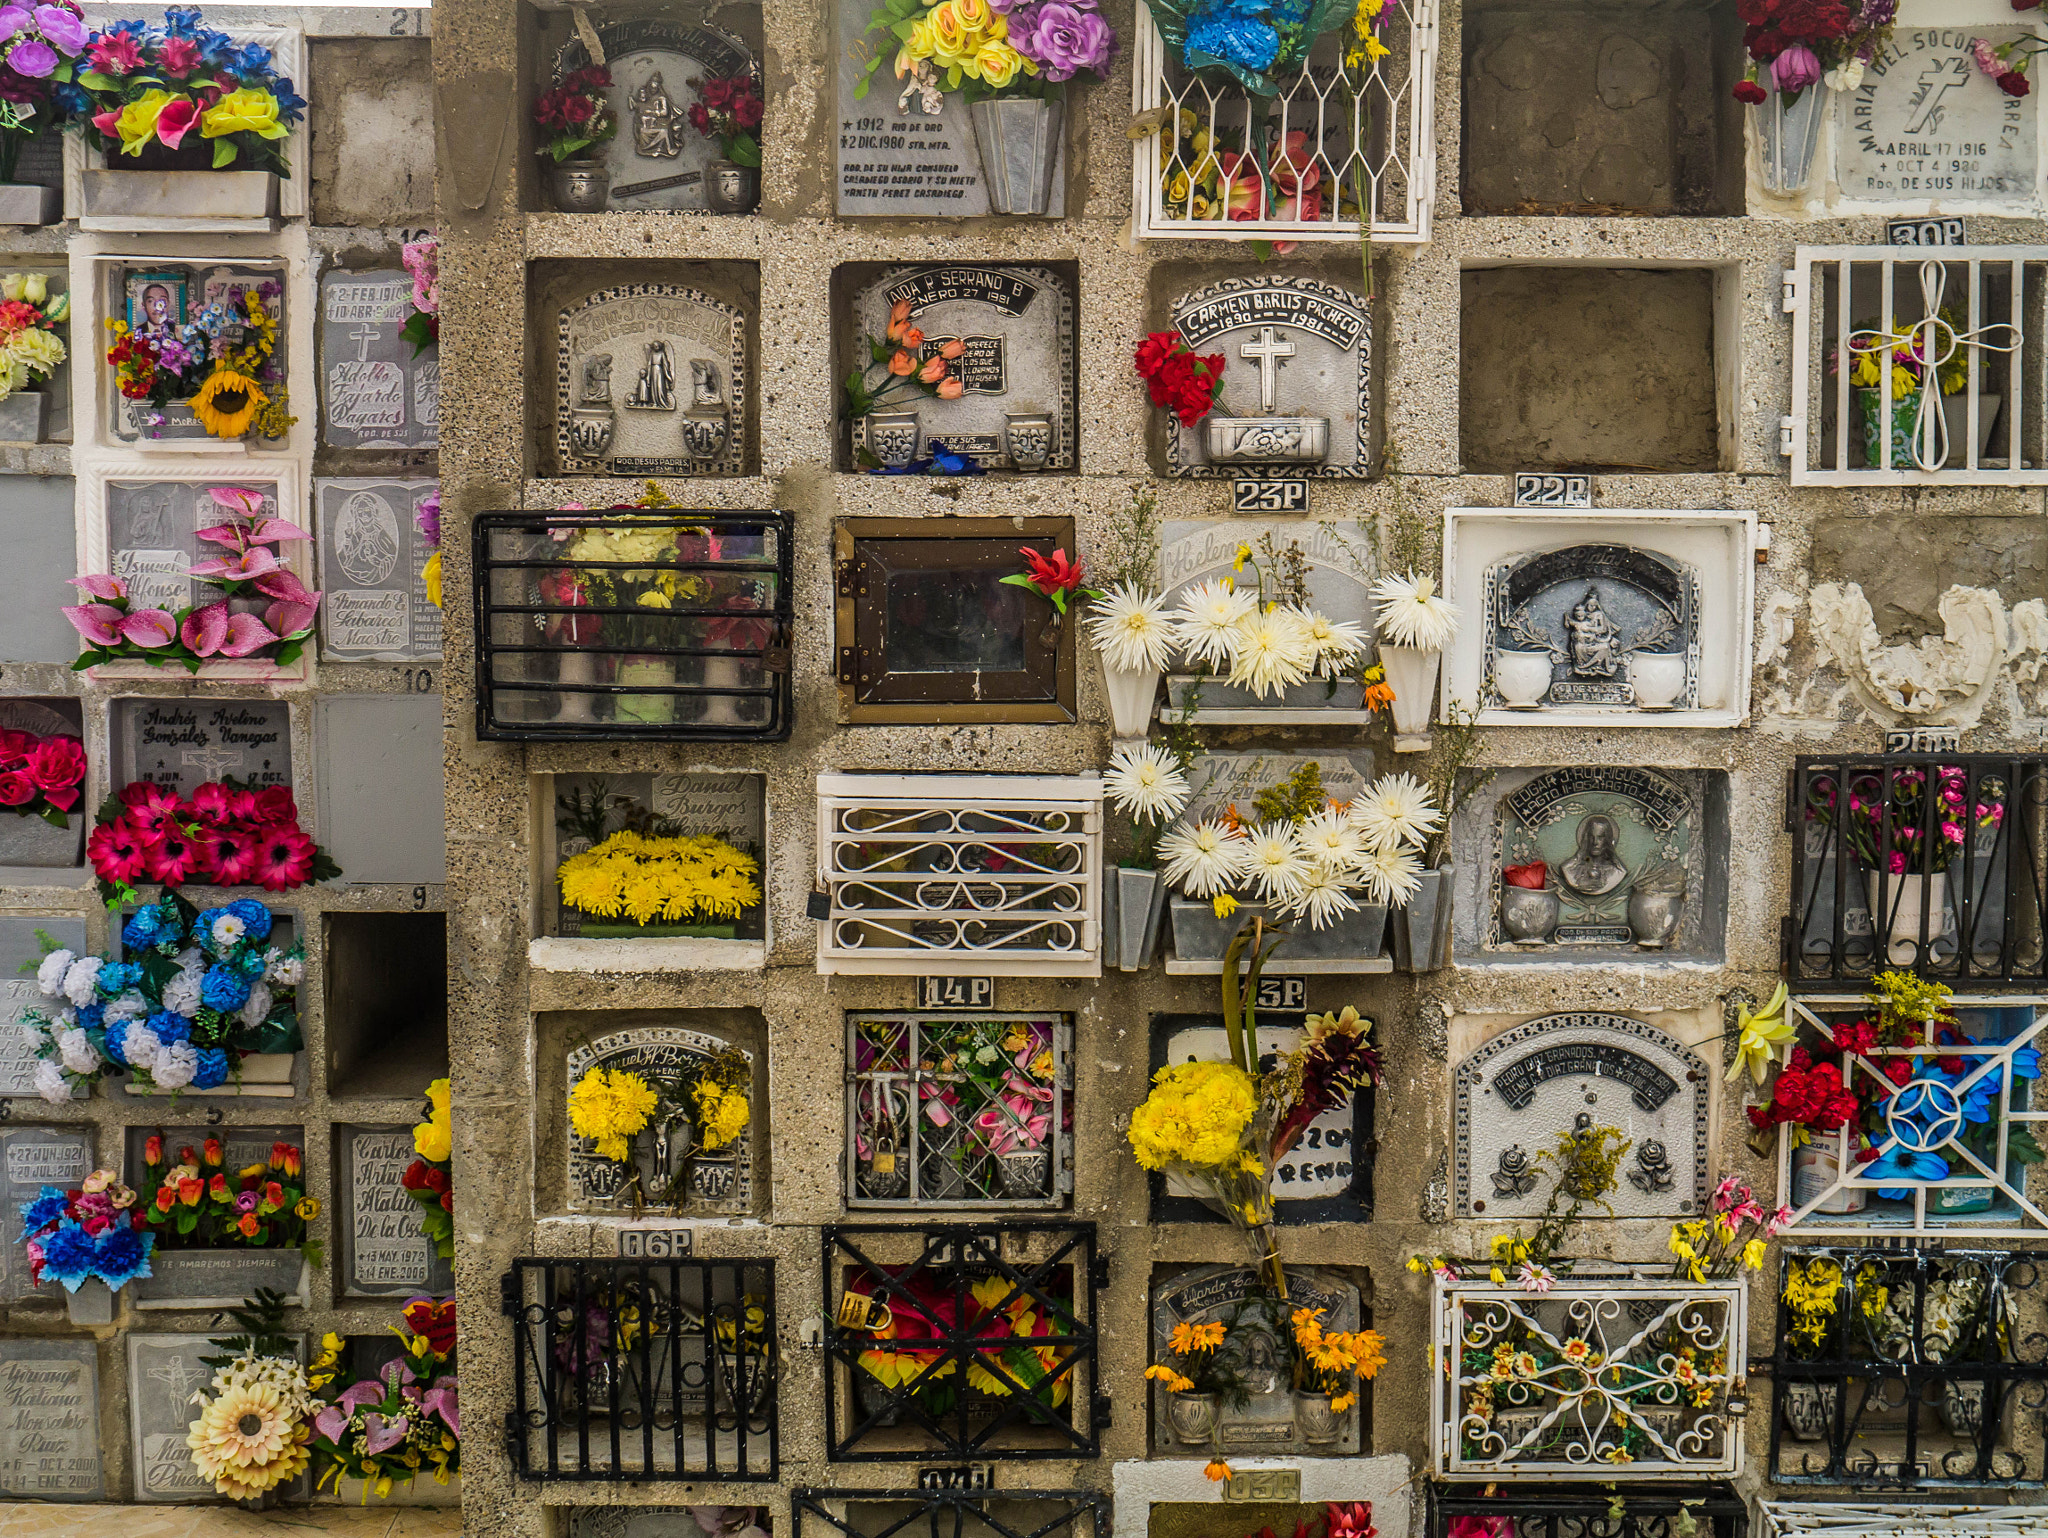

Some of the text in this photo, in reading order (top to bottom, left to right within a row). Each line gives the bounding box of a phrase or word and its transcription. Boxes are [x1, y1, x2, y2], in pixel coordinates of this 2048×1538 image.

[390, 8, 422, 35] 21
[1855, 30, 1978, 152] MARIA DEL SOCOR
[857, 118, 943, 132] 1912 RIO DE ORO
[849, 136, 857, 148] 2
[859, 135, 878, 149] DIC.
[880, 136, 905, 149] 1980
[1886, 143, 1987, 156] ABRIL 17 1916
[864, 164, 875, 172] DE
[877, 164, 890, 172] SU
[891, 164, 912, 172] HIJA
[916, 164, 959, 173] CONSUELO
[1897, 160, 1924, 171] OCT
[1932, 160, 1940, 171] 4
[892, 176, 924, 184] OSORIO
[927, 176, 935, 185] Y
[936, 176, 948, 185] SU
[1902, 177, 2004, 190] DE SUS HIJOS
[882, 188, 911, 198] PEREZ
[1892, 222, 1963, 245] 30P
[890, 270, 1023, 302] AIDA R SERRANO B
[963, 288, 979, 298] 27
[987, 291, 1010, 305] 1981
[1187, 292, 1360, 335] CARMEN BARLIS PACHECO
[1220, 312, 1251, 329] 1890
[331, 384, 403, 410] Fajardo
[1236, 482, 1304, 511] 23P
[1518, 476, 1586, 505] 22P
[405, 669, 432, 694] 10
[143, 708, 268, 727] Andrés Avelino
[142, 726, 279, 749] González Vanegas
[262, 772, 285, 782] OCT.
[661, 775, 746, 796] Daniel
[1512, 774, 1557, 808] EDGAR
[1574, 766, 1648, 788] RODRIGUEZ
[1648, 775, 1688, 809] LOPEZ
[667, 798, 748, 823] Burgos
[412, 886, 427, 911] 9
[1495, 1065, 1525, 1087] PEDRO
[1525, 1054, 1547, 1073] DIAZ
[1504, 1077, 1531, 1103] ELENA
[1546, 1063, 1567, 1079] DIAZ
[1567, 1061, 1615, 1075] GRANADOS
[356, 1137, 411, 1159] Carlos
[622, 1231, 691, 1257] 06P
[162, 1259, 277, 1268] TE AMAREMOS SIEMPRE
[379, 1250, 425, 1263] MAY. 1972
[400, 1266, 425, 1279] 2006
[68, 1457, 97, 1471] 2000
